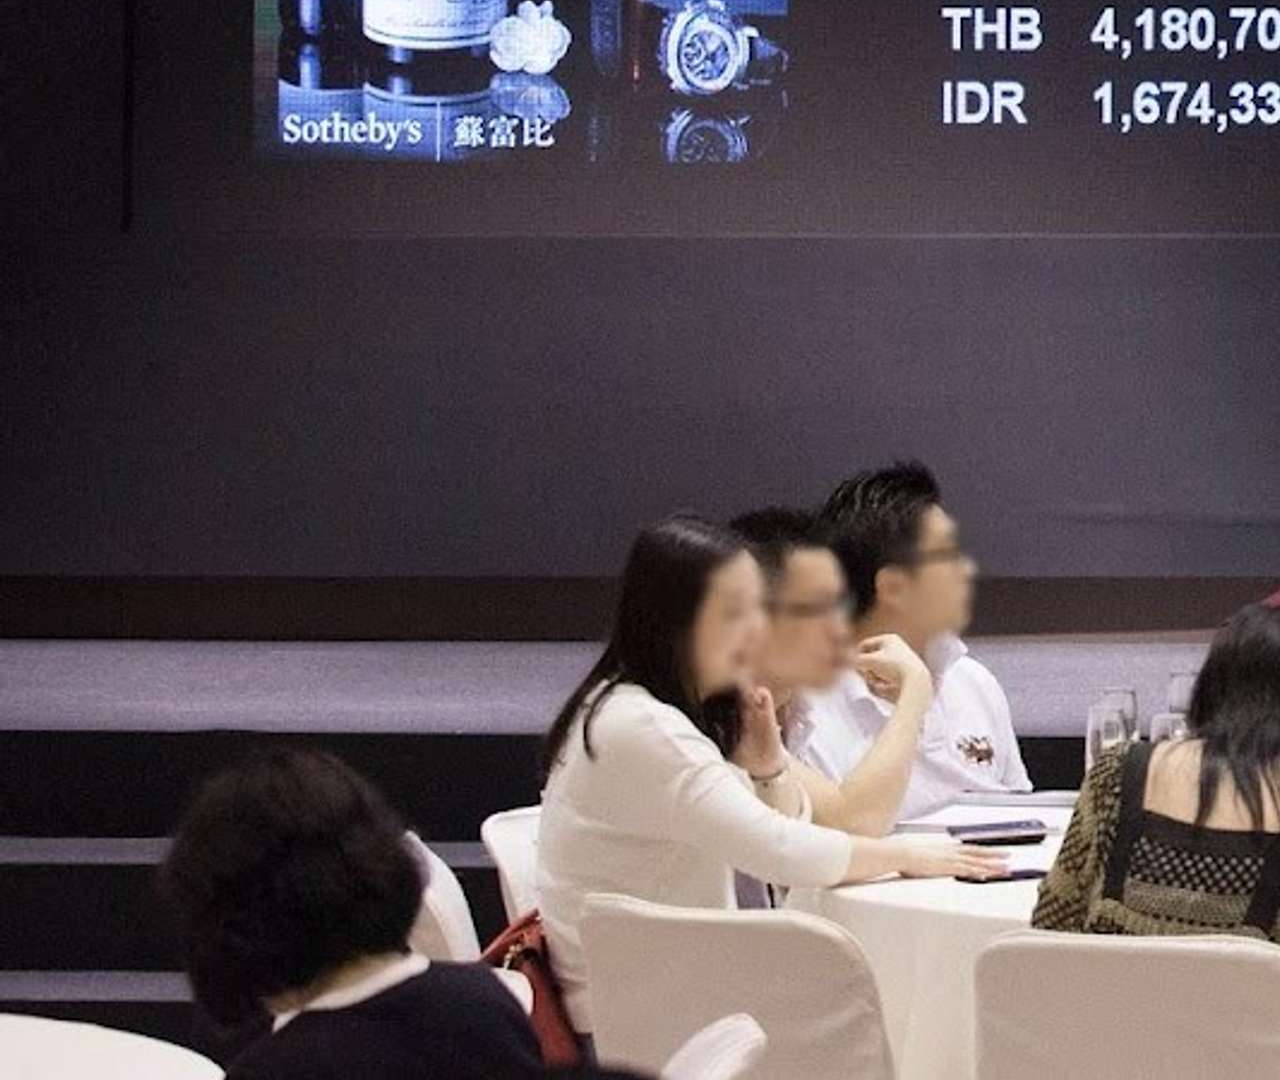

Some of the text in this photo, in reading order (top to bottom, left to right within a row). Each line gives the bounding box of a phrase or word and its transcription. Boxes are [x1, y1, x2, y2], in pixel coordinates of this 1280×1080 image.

[942, 8, 1042, 50] THB
[943, 81, 1027, 123] IDR
[282, 109, 423, 151] Sotheby's
[454, 115, 555, 149] 蘇富比
